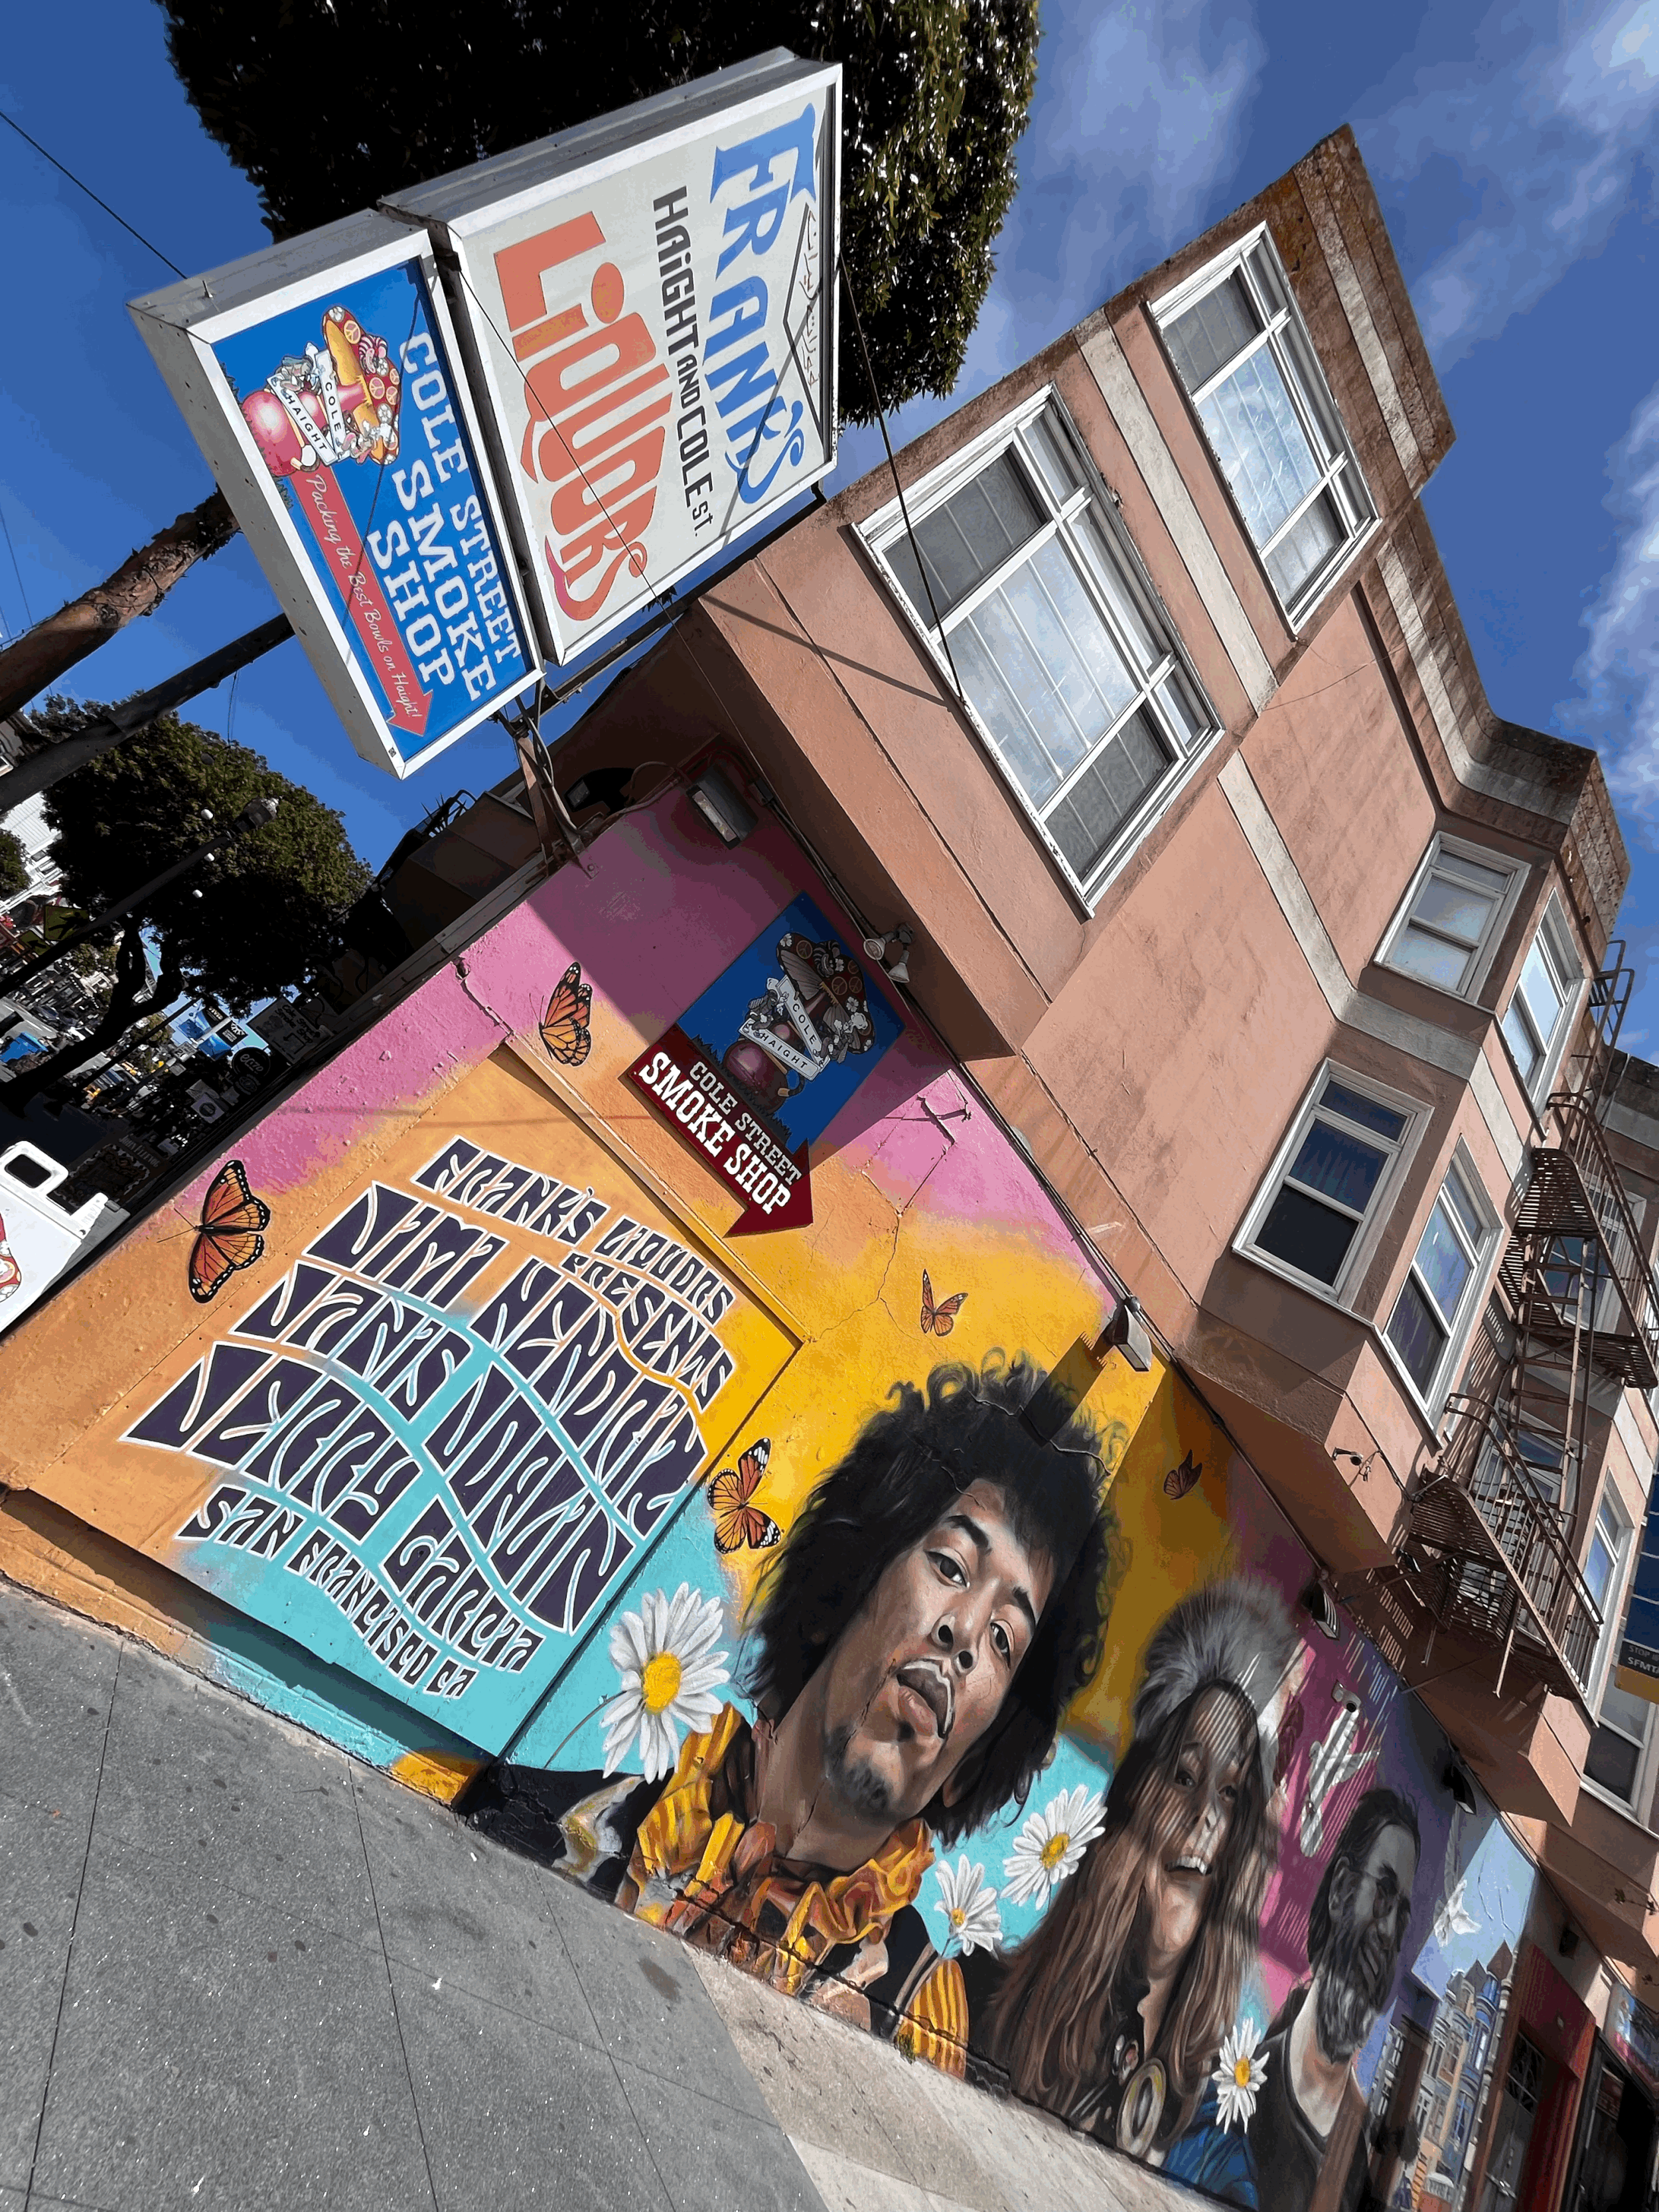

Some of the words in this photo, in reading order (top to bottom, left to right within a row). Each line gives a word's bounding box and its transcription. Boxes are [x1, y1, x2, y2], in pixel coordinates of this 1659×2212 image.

[286, 394, 327, 450] HAIGHT
[325, 381, 342, 431] COLE
[676, 353, 699, 411] AND
[399, 331, 469, 484] COLE
[450, 494, 522, 664] STREET
[677, 405, 713, 508] COLE
[305, 473, 342, 546] Packing
[335, 544, 356, 569] the
[348, 571, 374, 607] Best
[364, 608, 393, 653] Bowls
[383, 655, 397, 672] on
[391, 671, 423, 718] Haight!
[368, 520, 456, 686] SHOP
[392, 459, 496, 702] SMOKE
[760, 1032, 810, 1071] HAIGHT
[792, 1002, 817, 1046] COLE
[638, 1051, 735, 1158] SMOKE
[723, 1142, 792, 1215] SHOP
[689, 1061, 739, 1116] COLE
[735, 1112, 802, 1187] STREET
[301, 1180, 511, 1313] JIMI
[228, 1260, 474, 1425] JANIS
[118, 1341, 423, 1546] JERRY
[174, 1483, 307, 1562] SAN
[283, 1524, 441, 1688] FRANCISCO
[423, 1658, 480, 1700] CA
[1628, 1645, 1650, 1658] STOP
